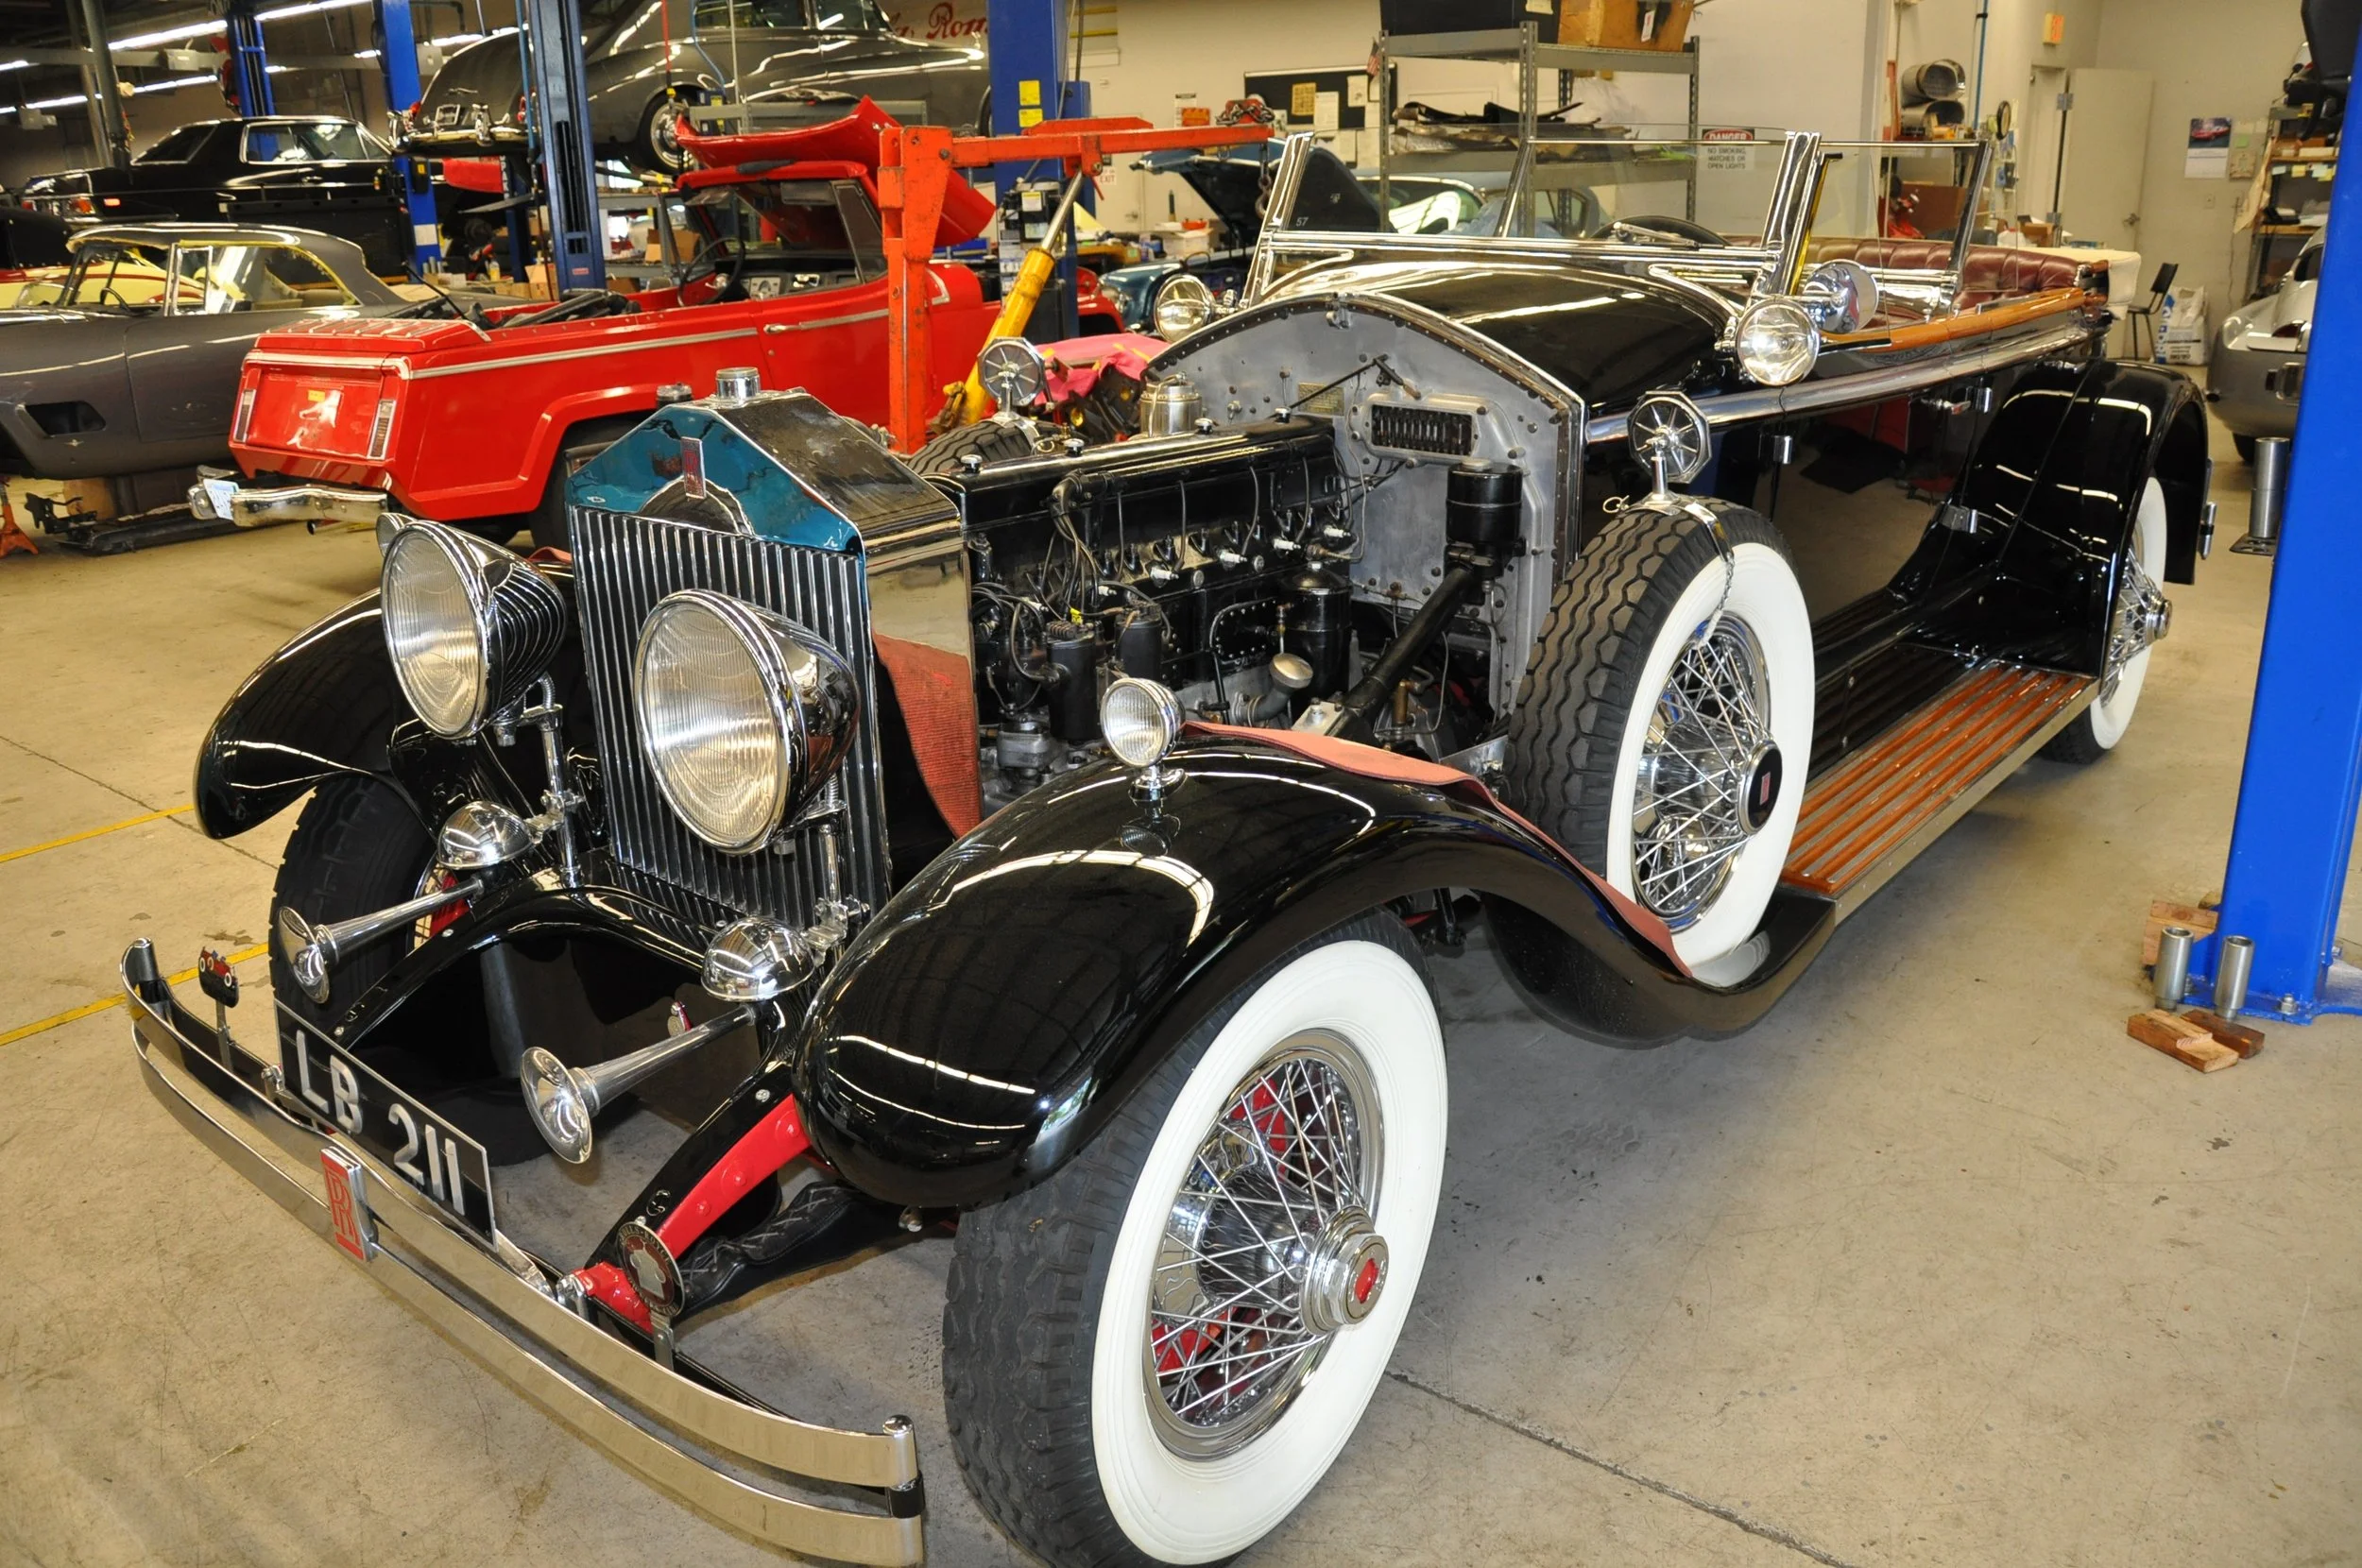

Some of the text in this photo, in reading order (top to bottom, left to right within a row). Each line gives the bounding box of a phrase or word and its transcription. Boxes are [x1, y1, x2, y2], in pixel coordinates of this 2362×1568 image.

[1709, 132, 1747, 141] DANGER
[1100, 175, 1115, 183] EXIT
[1295, 216, 1309, 227] 57
[296, 1030, 465, 1217] LB 211
